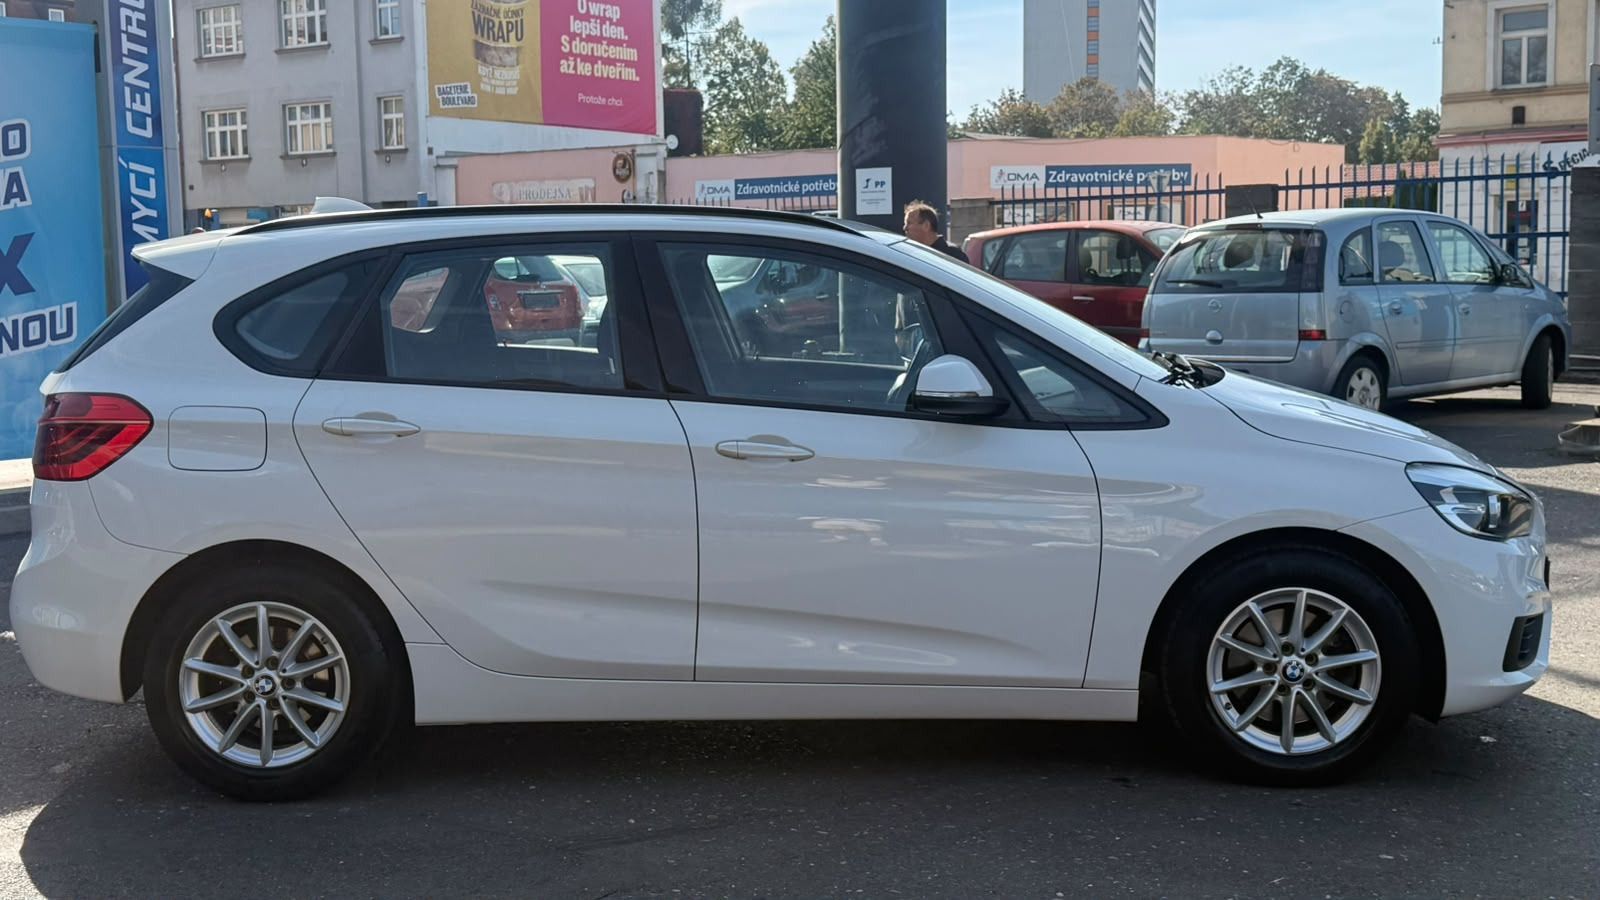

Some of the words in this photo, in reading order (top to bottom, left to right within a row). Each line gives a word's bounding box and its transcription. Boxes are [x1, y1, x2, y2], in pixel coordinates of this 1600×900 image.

[588, 1, 621, 22] wrap
[472, 10, 524, 43] WRAPU
[602, 21, 628, 40] den.
[561, 34, 570, 53] S
[560, 57, 576, 74] až
[576, 57, 592, 76] ke
[1007, 172, 1040, 182] DMA
[1048, 168, 1134, 183] Zdravotnické
[707, 185, 731, 195] DMA
[736, 180, 800, 195] Zdravotnické
[0, 232, 36, 296] X
